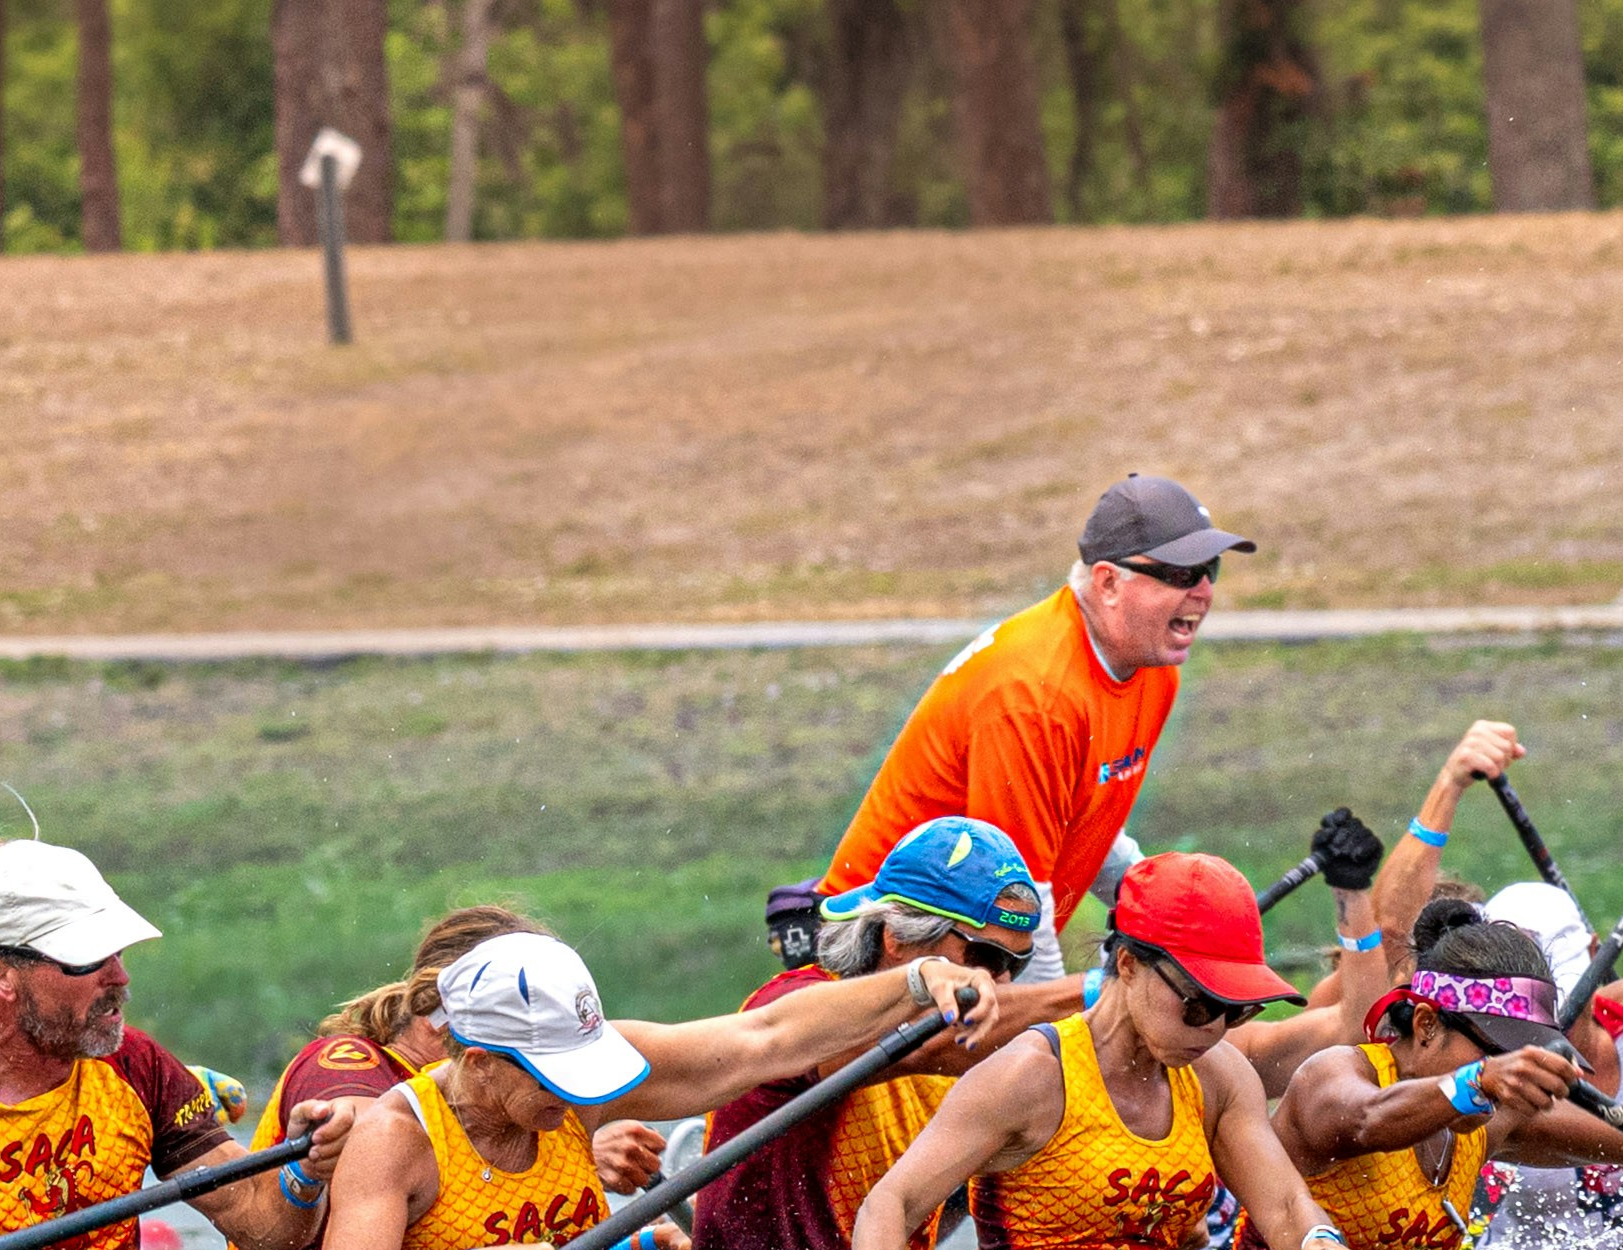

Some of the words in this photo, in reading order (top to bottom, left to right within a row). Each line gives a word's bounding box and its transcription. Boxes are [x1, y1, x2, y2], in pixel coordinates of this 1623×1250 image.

[999, 911, 1030, 927] 2013
[1102, 1165, 1215, 1208] SACA
[482, 1186, 601, 1247] SACA
